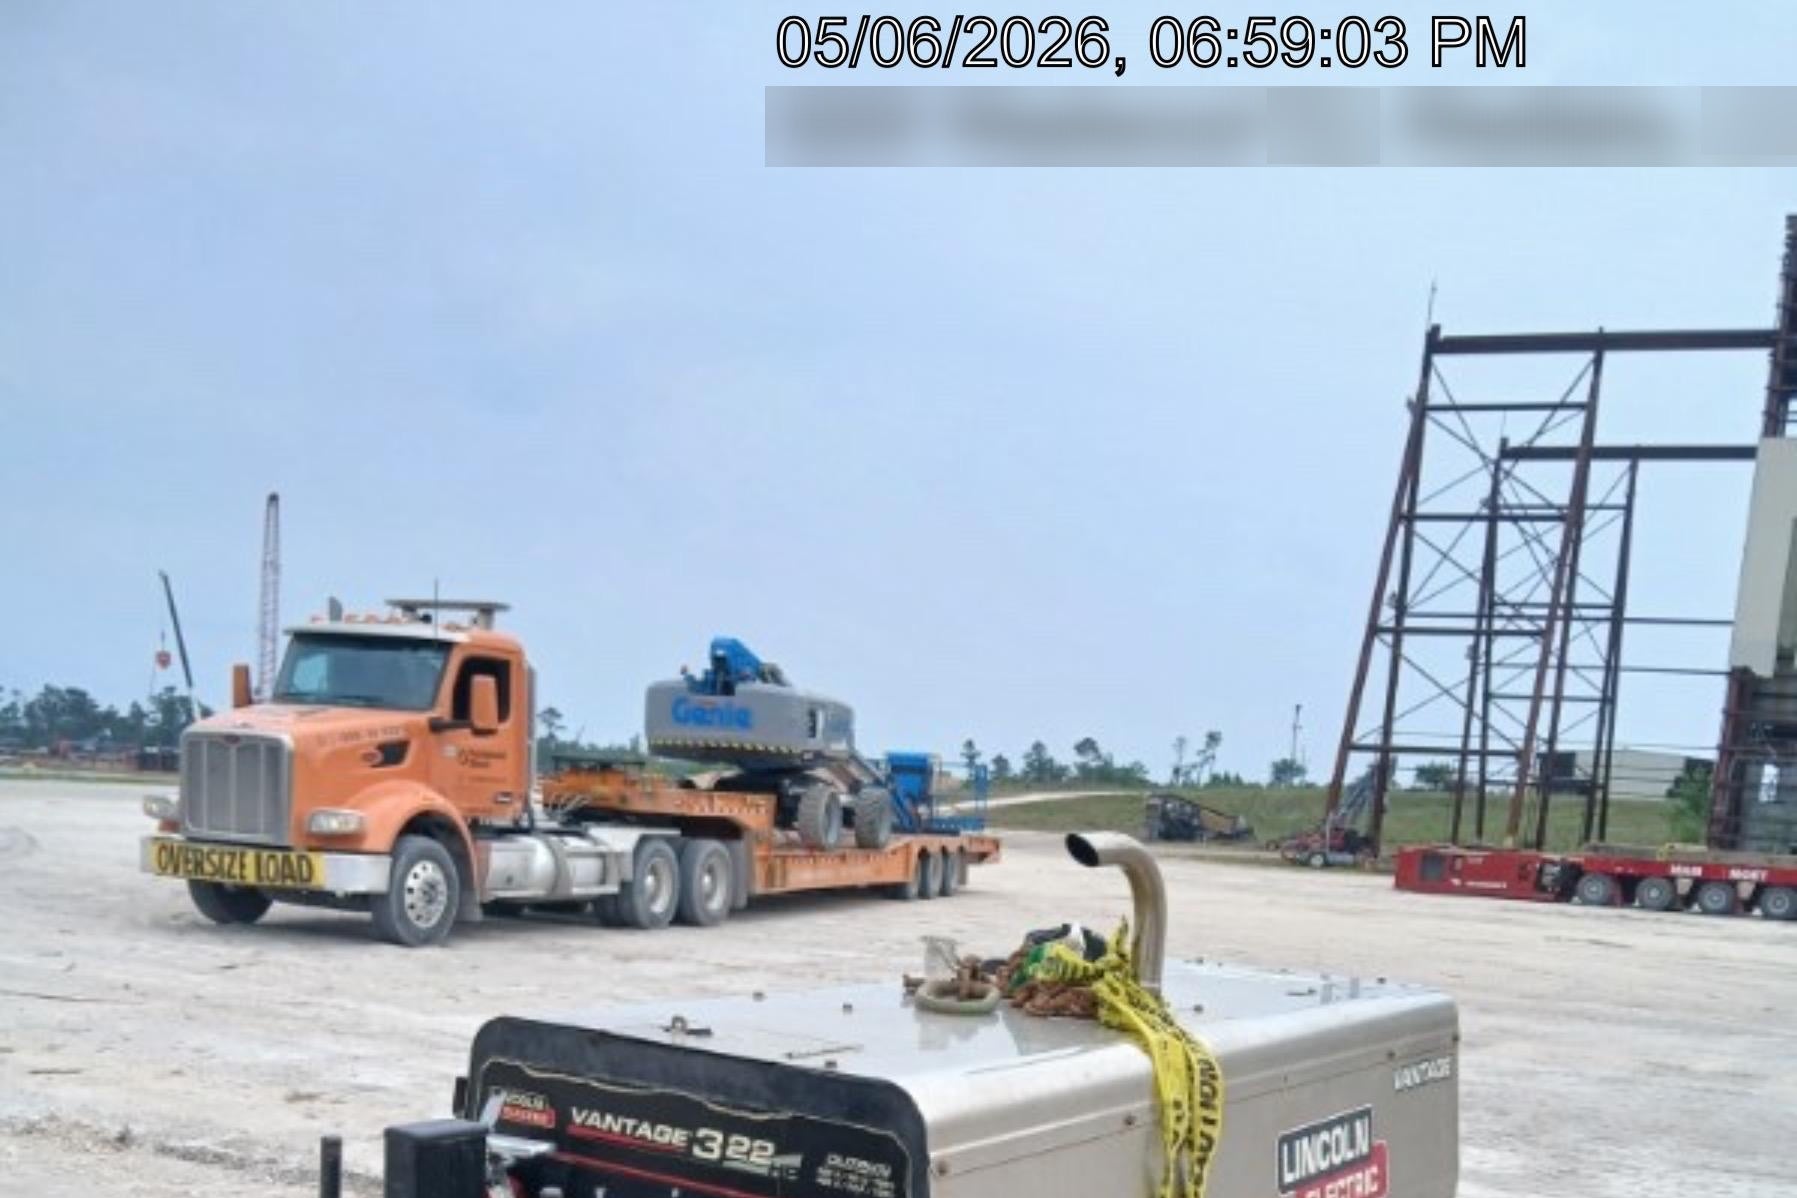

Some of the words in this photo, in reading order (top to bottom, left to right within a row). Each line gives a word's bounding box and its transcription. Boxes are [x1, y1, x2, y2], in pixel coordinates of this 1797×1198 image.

[671, 696, 753, 730] Genie
[156, 842, 247, 881] OVERSIZE
[255, 853, 313, 884] LOAD
[571, 1106, 689, 1146] VANTAGE
[692, 1127, 775, 1166] 322
[1282, 1115, 1370, 1184] LINCOLN
